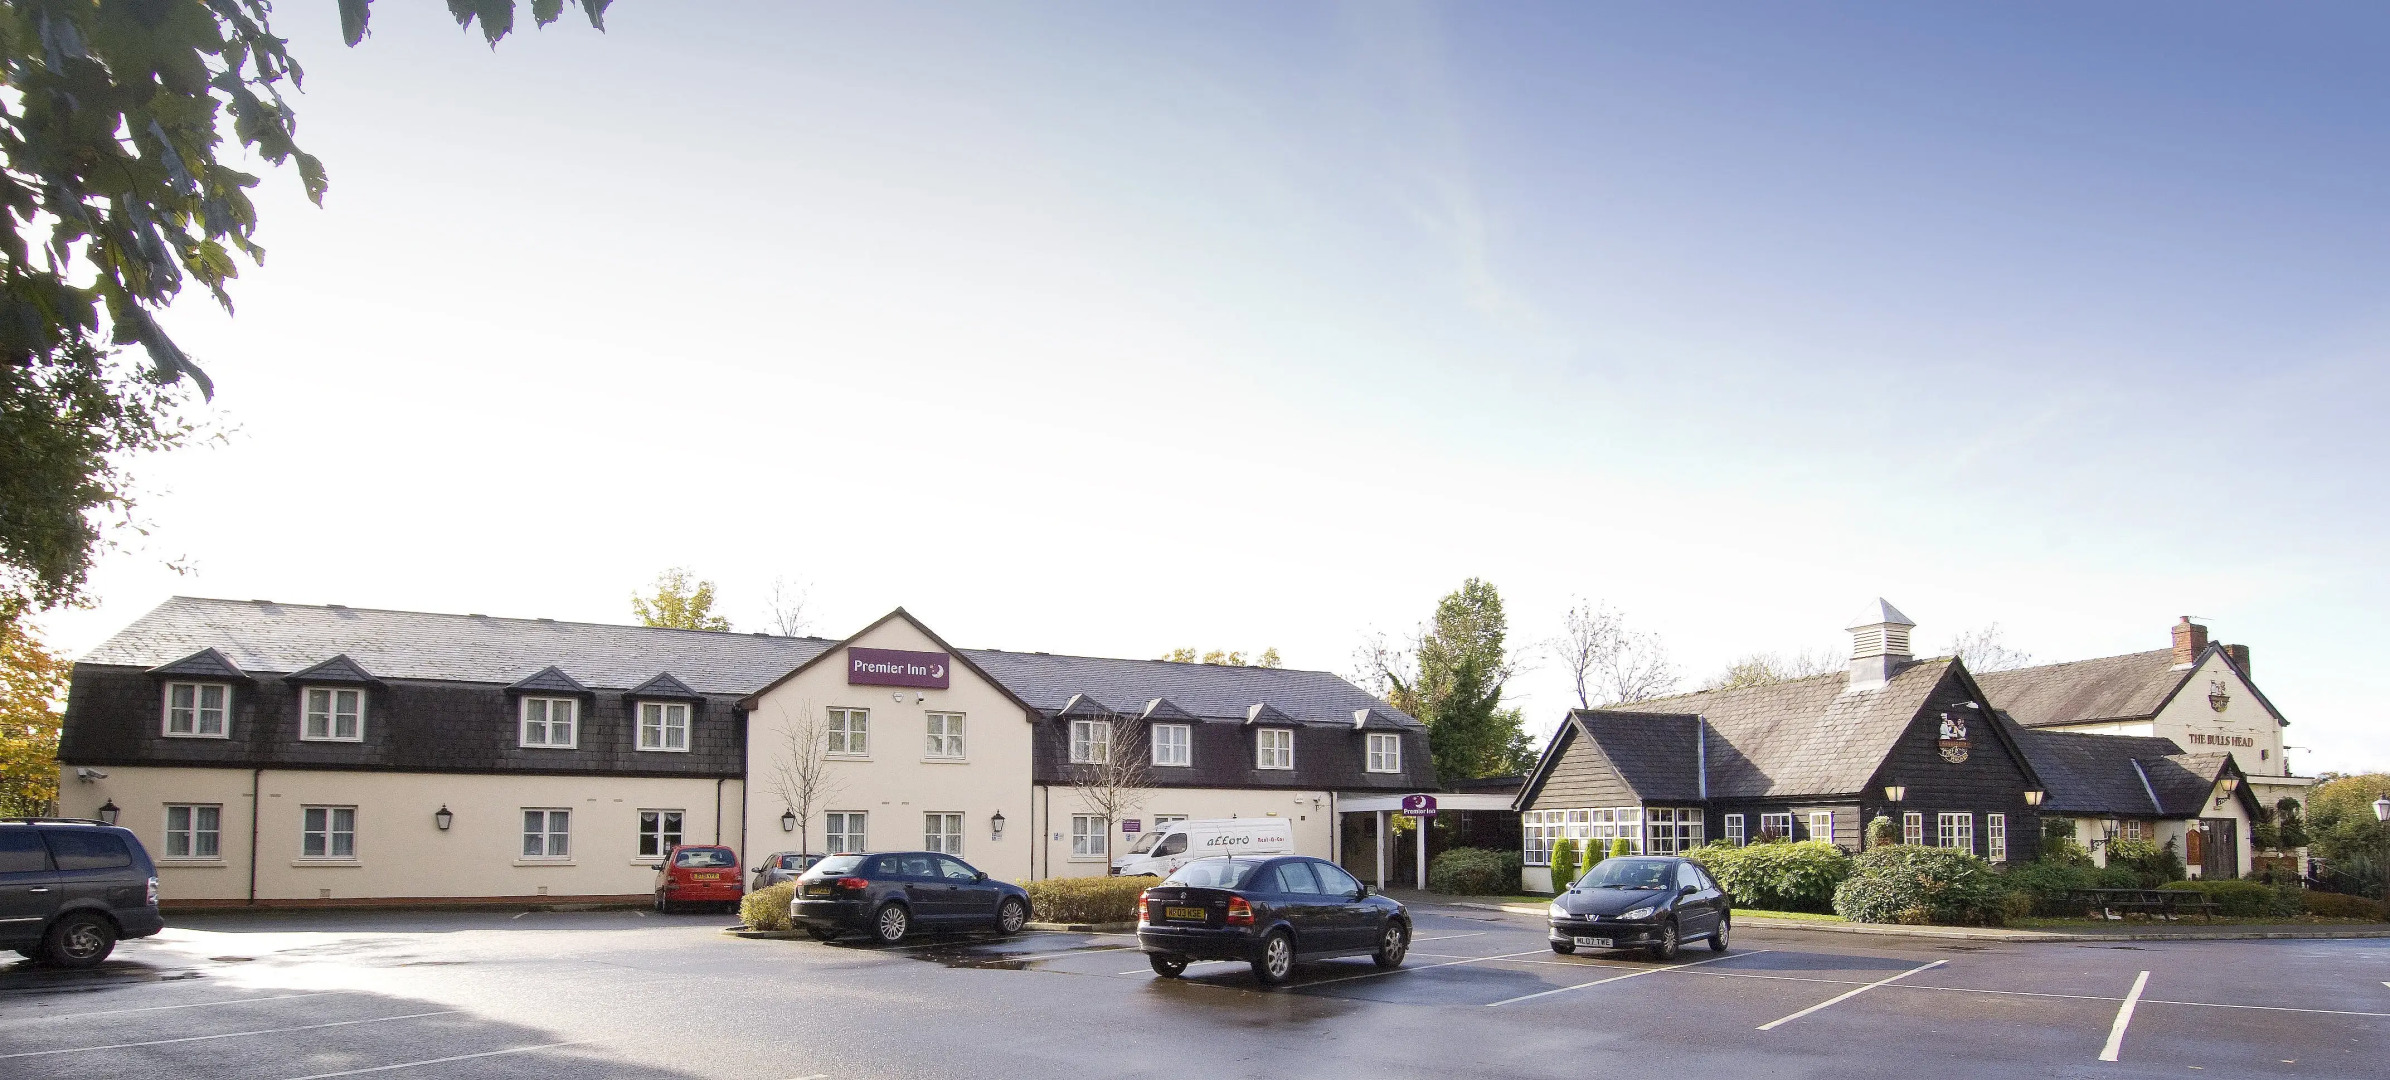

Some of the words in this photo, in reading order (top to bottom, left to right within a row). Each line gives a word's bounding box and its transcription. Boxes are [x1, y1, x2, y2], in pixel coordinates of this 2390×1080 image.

[854, 660, 904, 674] Premier
[907, 663, 927, 676] Inn
[2188, 733, 2206, 744] THE
[2207, 735, 2231, 746] BULLS
[2231, 736, 2254, 747] HEAD
